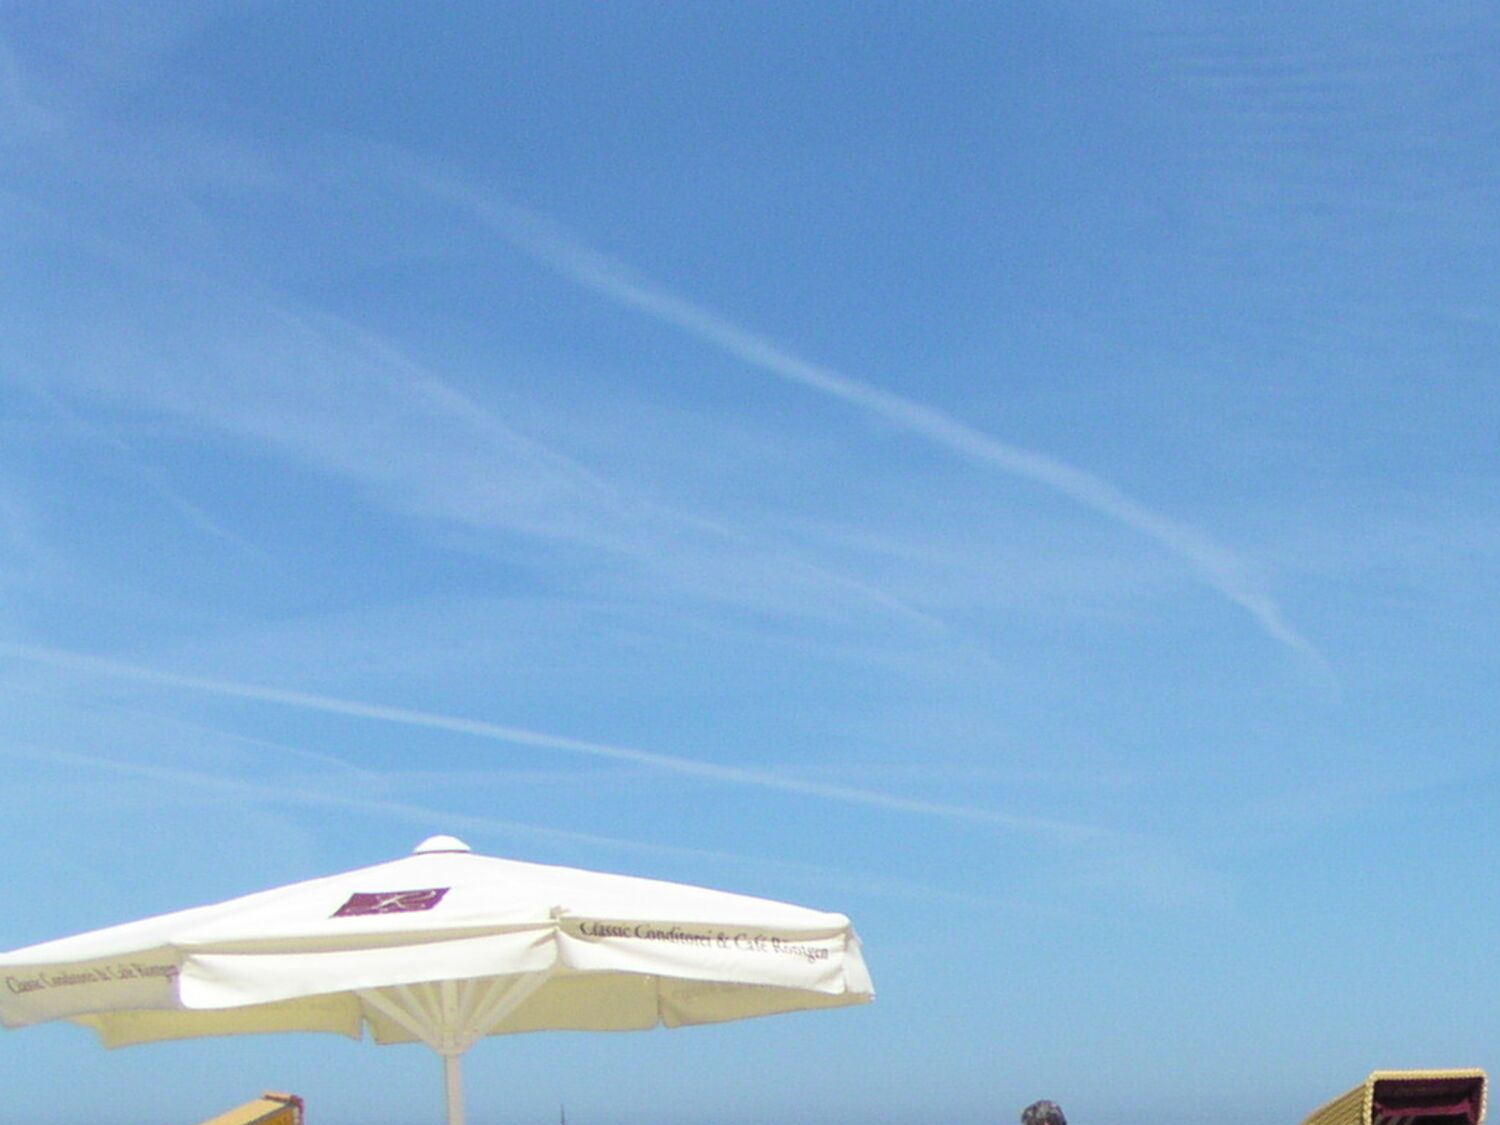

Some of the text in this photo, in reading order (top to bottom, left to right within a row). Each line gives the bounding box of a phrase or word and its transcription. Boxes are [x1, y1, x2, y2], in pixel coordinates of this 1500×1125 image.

[579, 919, 632, 938] Classic
[634, 923, 712, 947] Conditorei
[717, 930, 731, 949] &
[733, 931, 768, 953] Café
